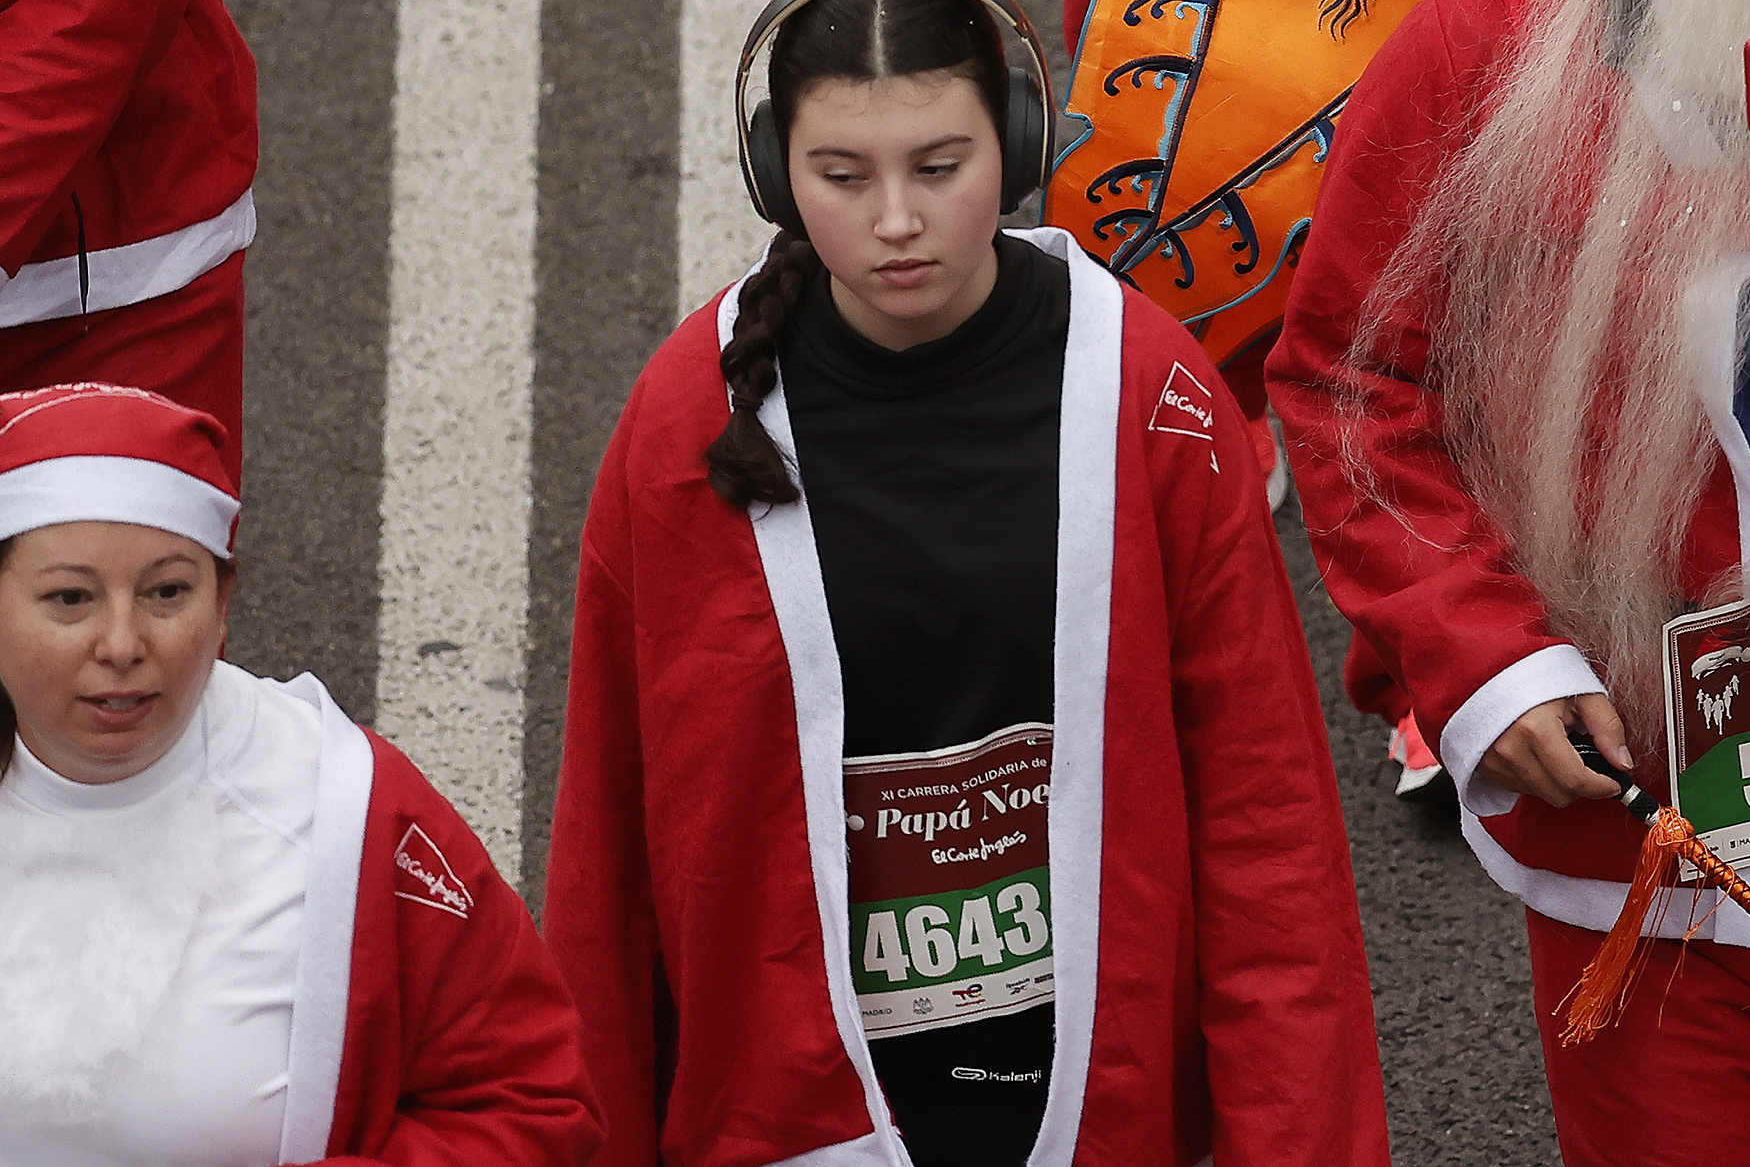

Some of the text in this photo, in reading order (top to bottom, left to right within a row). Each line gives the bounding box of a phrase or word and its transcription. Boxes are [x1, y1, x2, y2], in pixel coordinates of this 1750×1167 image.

[881, 757, 1048, 802] XI CARRERA SOLIDARIA de
[876, 783, 1050, 843] Papá Noe
[931, 830, 1027, 865] El Corte Inglés
[864, 882, 1050, 983] 4643
[989, 1070, 1041, 1083] Kalenji
